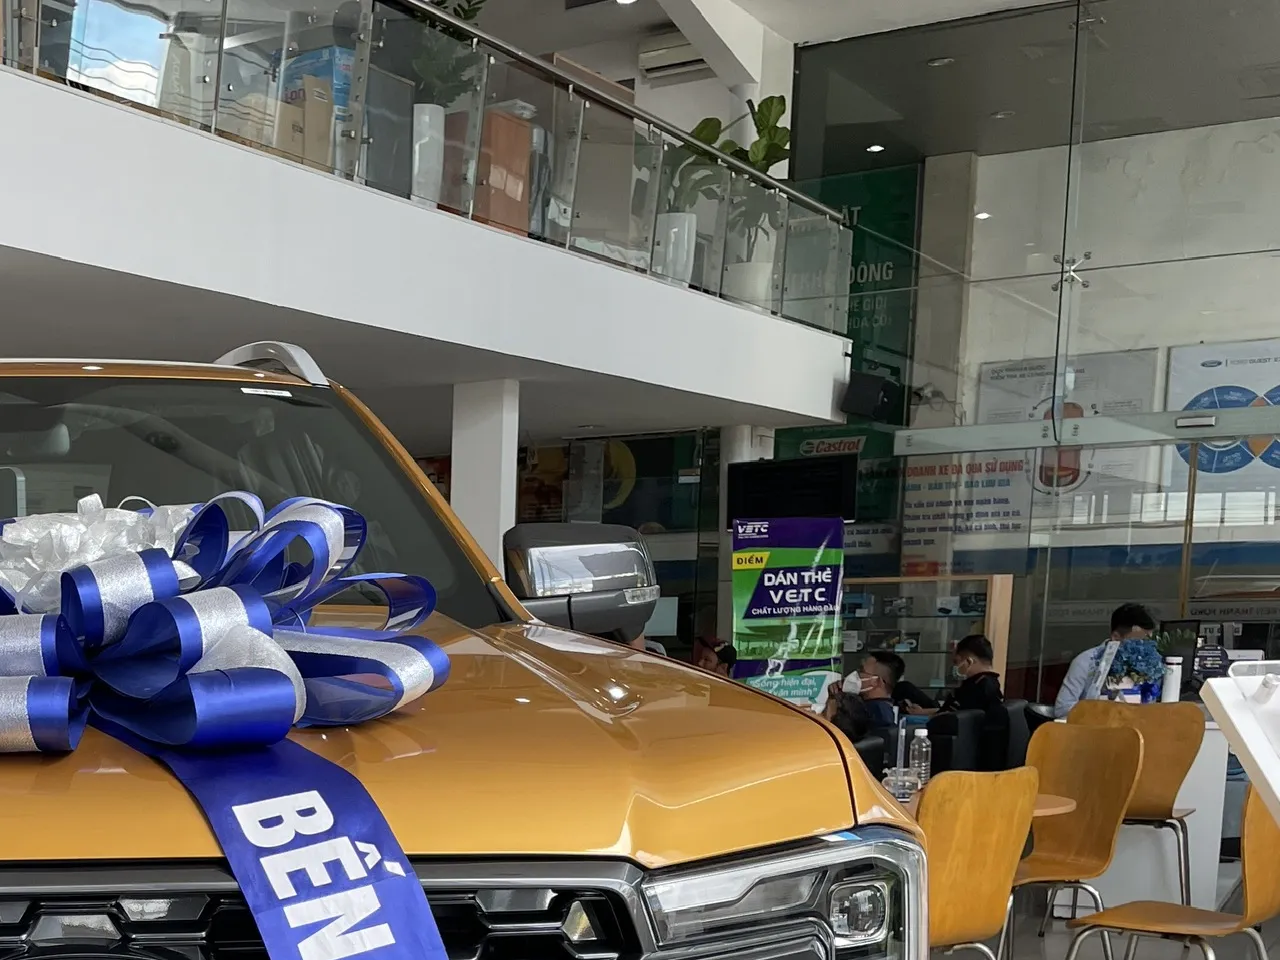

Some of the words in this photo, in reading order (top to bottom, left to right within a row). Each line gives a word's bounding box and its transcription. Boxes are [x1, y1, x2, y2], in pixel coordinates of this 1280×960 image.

[815, 438, 861, 453] Castrol
[738, 524, 769, 534] VETC
[736, 554, 764, 565] ĐIỂM
[764, 570, 797, 586] DÁN
[800, 567, 832, 584] THẺ
[769, 587, 826, 604] VETC
[751, 604, 772, 616] CHẤT
[773, 604, 802, 616] LƯỢNG
[802, 602, 823, 613] HÀNG
[781, 678, 800, 687] hiện
